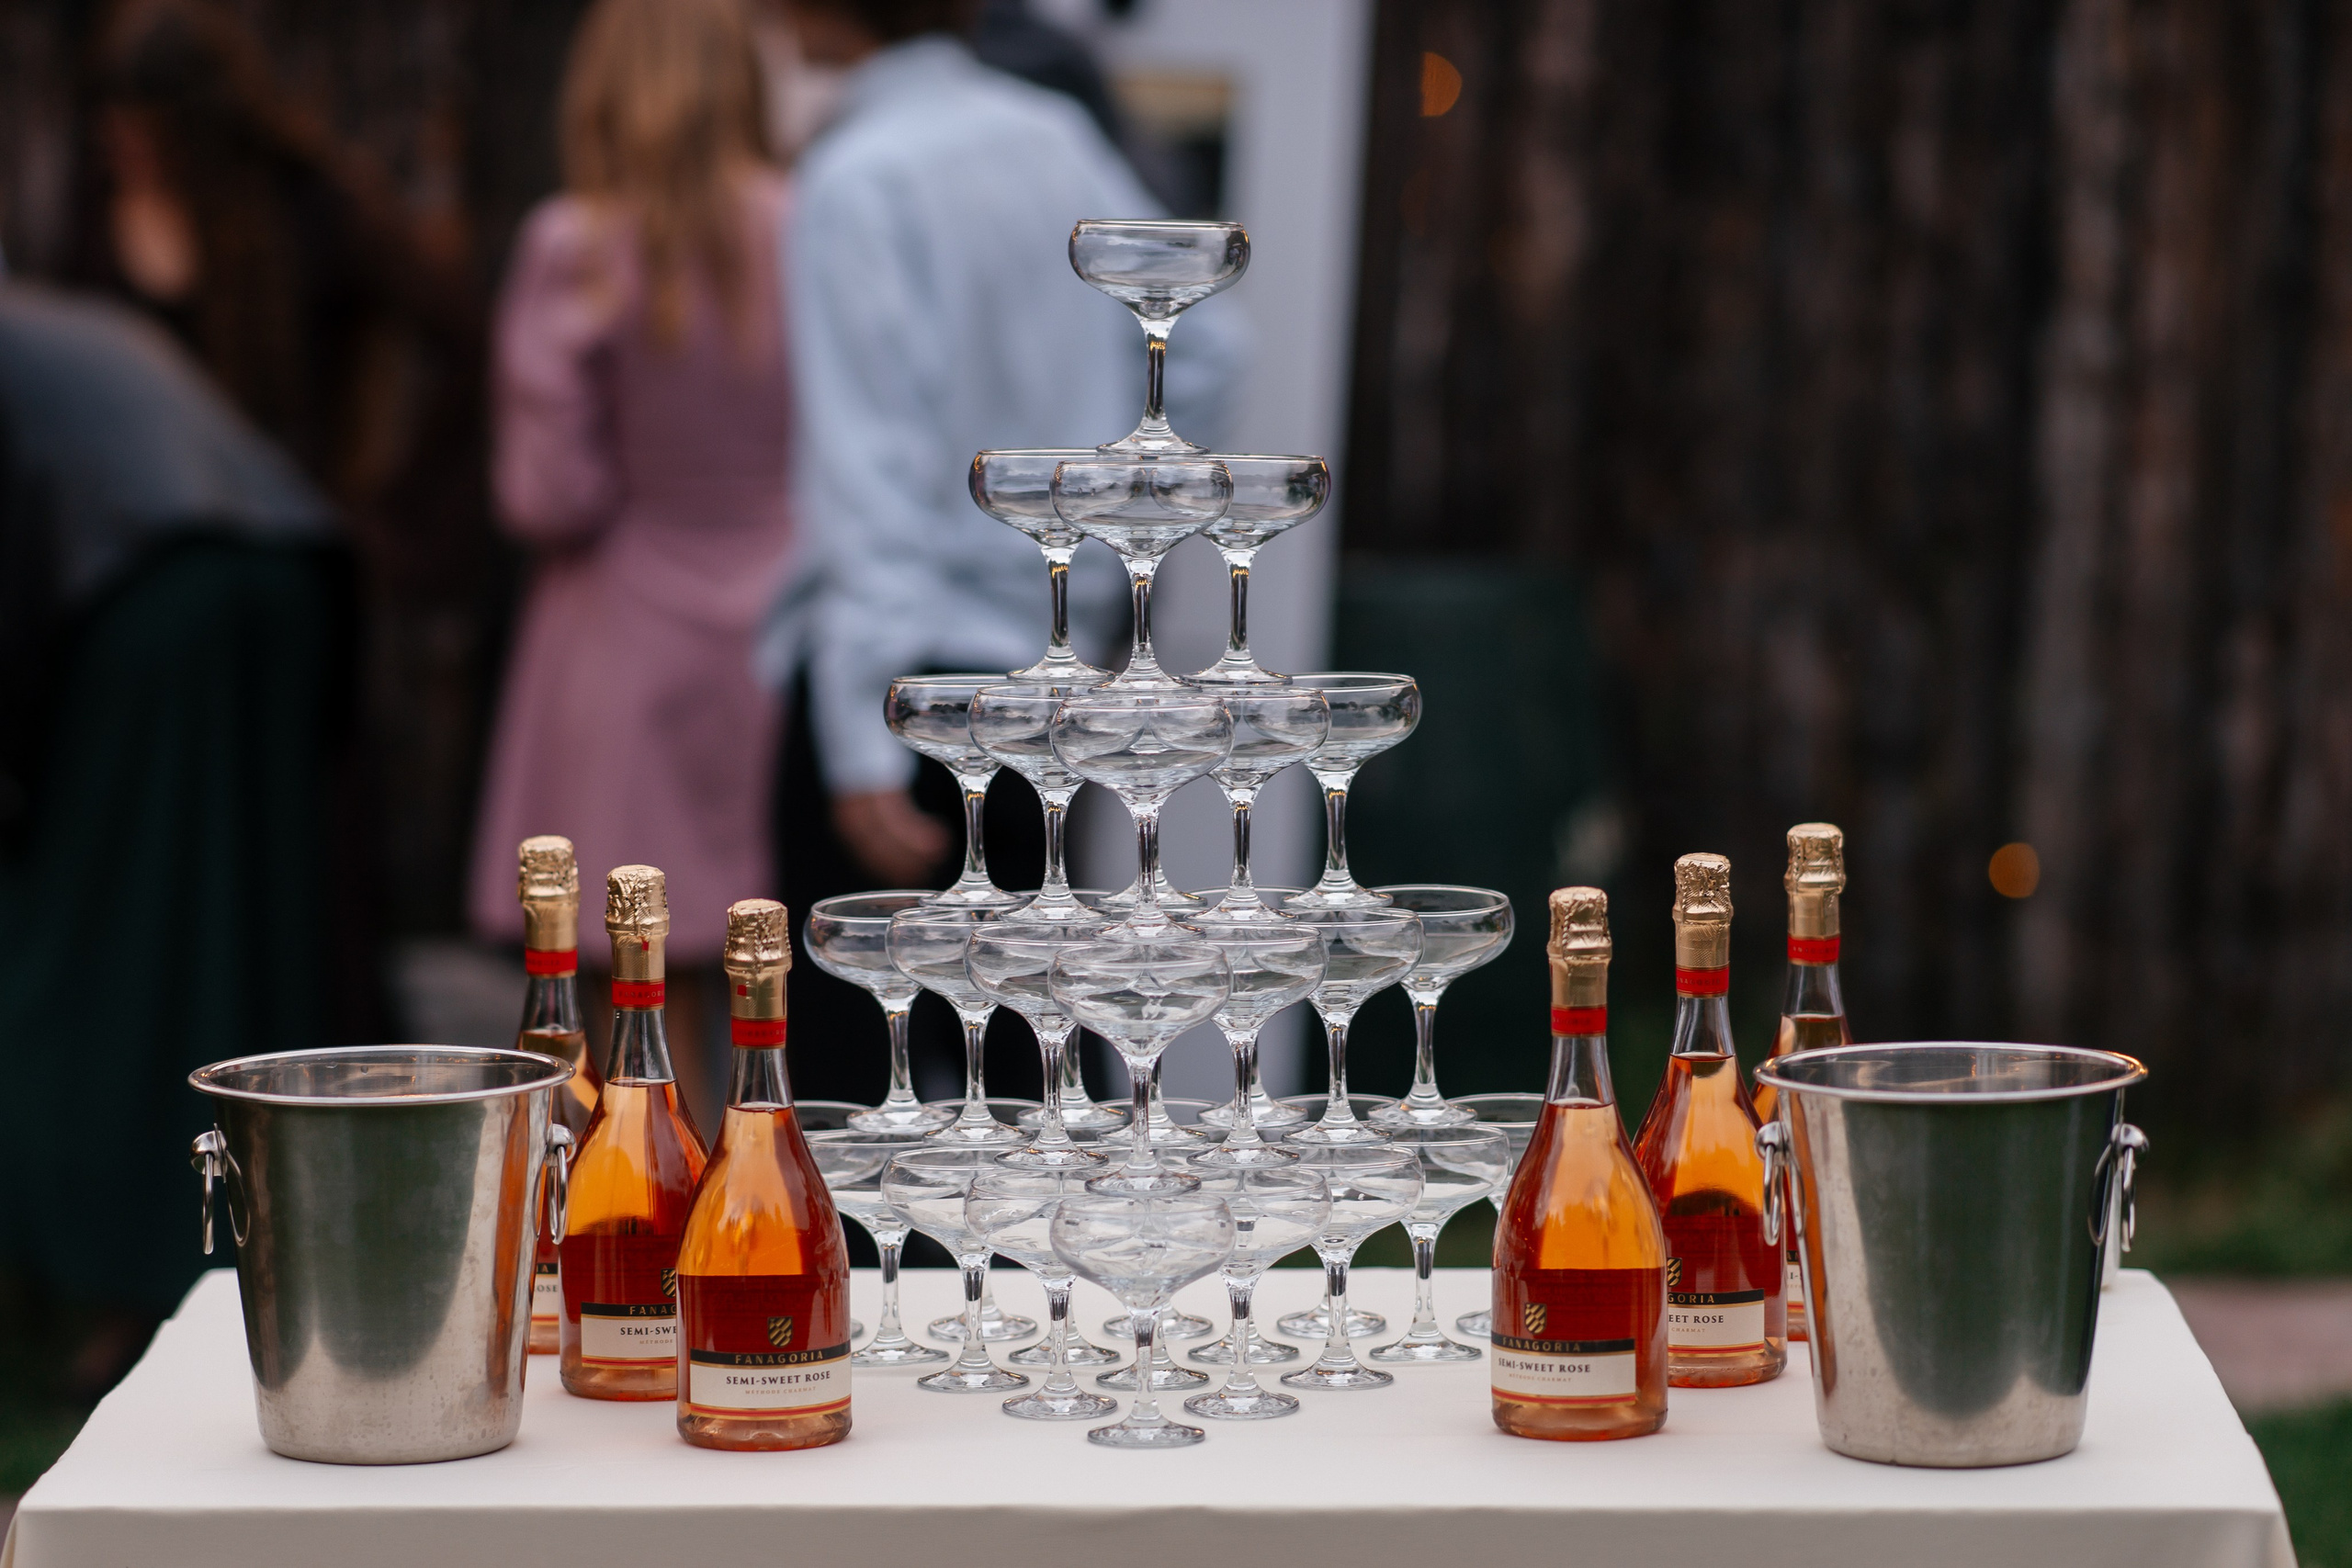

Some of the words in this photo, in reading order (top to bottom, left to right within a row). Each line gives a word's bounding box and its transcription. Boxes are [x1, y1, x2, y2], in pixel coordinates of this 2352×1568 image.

[537, 1284, 558, 1292] OSE
[1668, 1293, 1715, 1303] GORIA
[629, 1305, 676, 1314] FANAG
[1693, 1314, 1724, 1324] ROSE
[620, 1325, 677, 1336] SEMI-SWE
[1502, 1337, 1581, 1352] FANAGORIA
[735, 1350, 823, 1365] FANAGORIA
[1498, 1357, 1555, 1372] SEMI-SWEET
[1559, 1364, 1591, 1373] ROSE
[726, 1374, 801, 1385] SEMI-SWEET
[805, 1371, 831, 1382] ROSE
